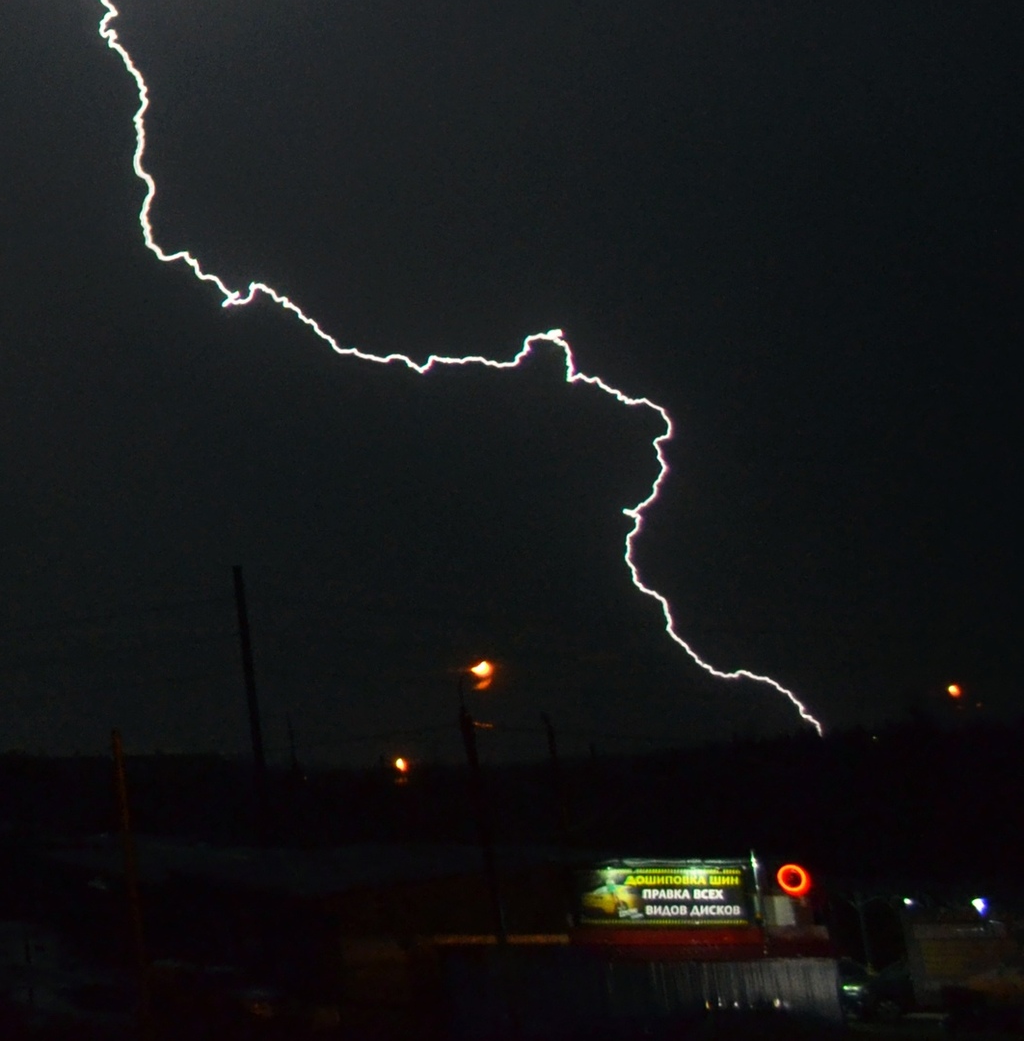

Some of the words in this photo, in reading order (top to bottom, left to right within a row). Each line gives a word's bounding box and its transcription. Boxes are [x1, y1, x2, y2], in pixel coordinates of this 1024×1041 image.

[624, 875, 707, 885] ДОШИПОВКА
[709, 875, 739, 885] ШИН
[642, 889, 691, 899] ПРАВКА
[693, 889, 724, 899] ВСЕХ
[645, 905, 688, 916] ВИДОВ
[689, 905, 741, 916] ДИСКОВ
